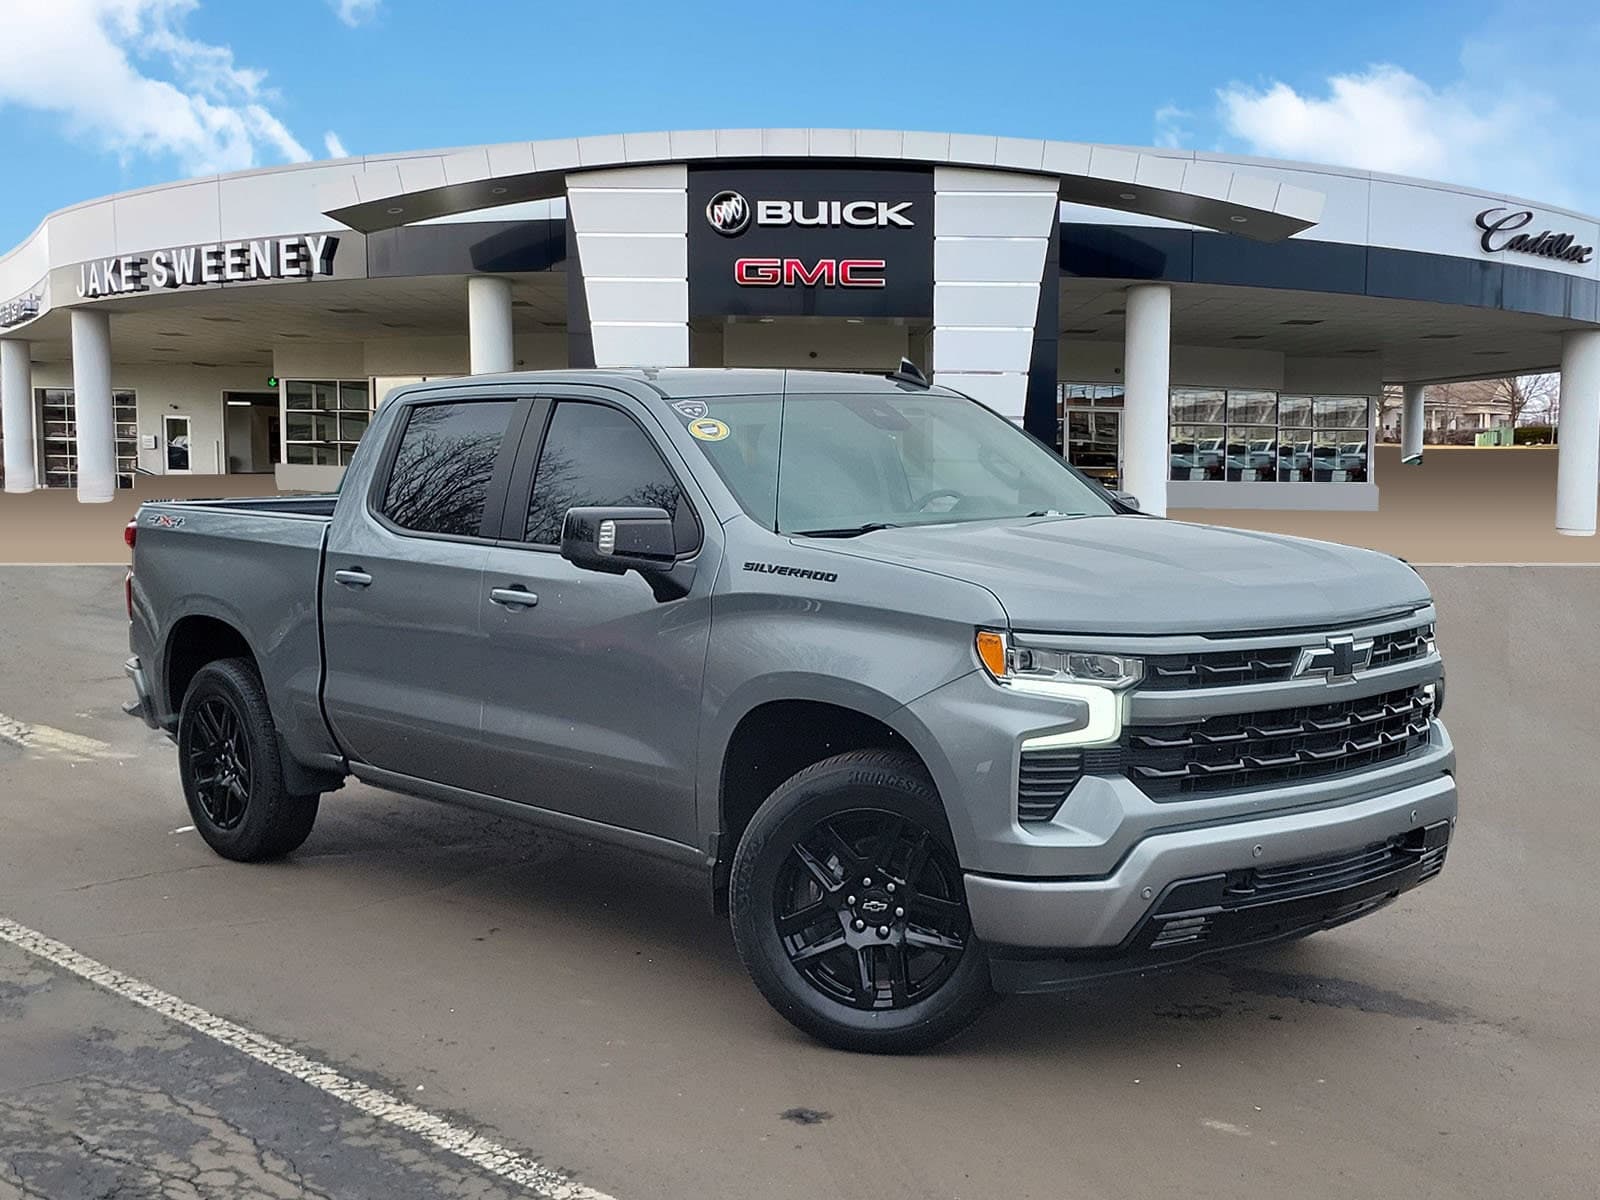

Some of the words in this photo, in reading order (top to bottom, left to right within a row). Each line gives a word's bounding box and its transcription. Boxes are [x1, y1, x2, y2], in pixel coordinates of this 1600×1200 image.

[757, 200, 915, 226] BUICK
[1475, 207, 1593, 263] Cadillac
[76, 256, 138, 298] JAKE
[152, 234, 331, 288] SWEENEY
[735, 258, 886, 286] GMC
[742, 561, 838, 583] SILVERADO
